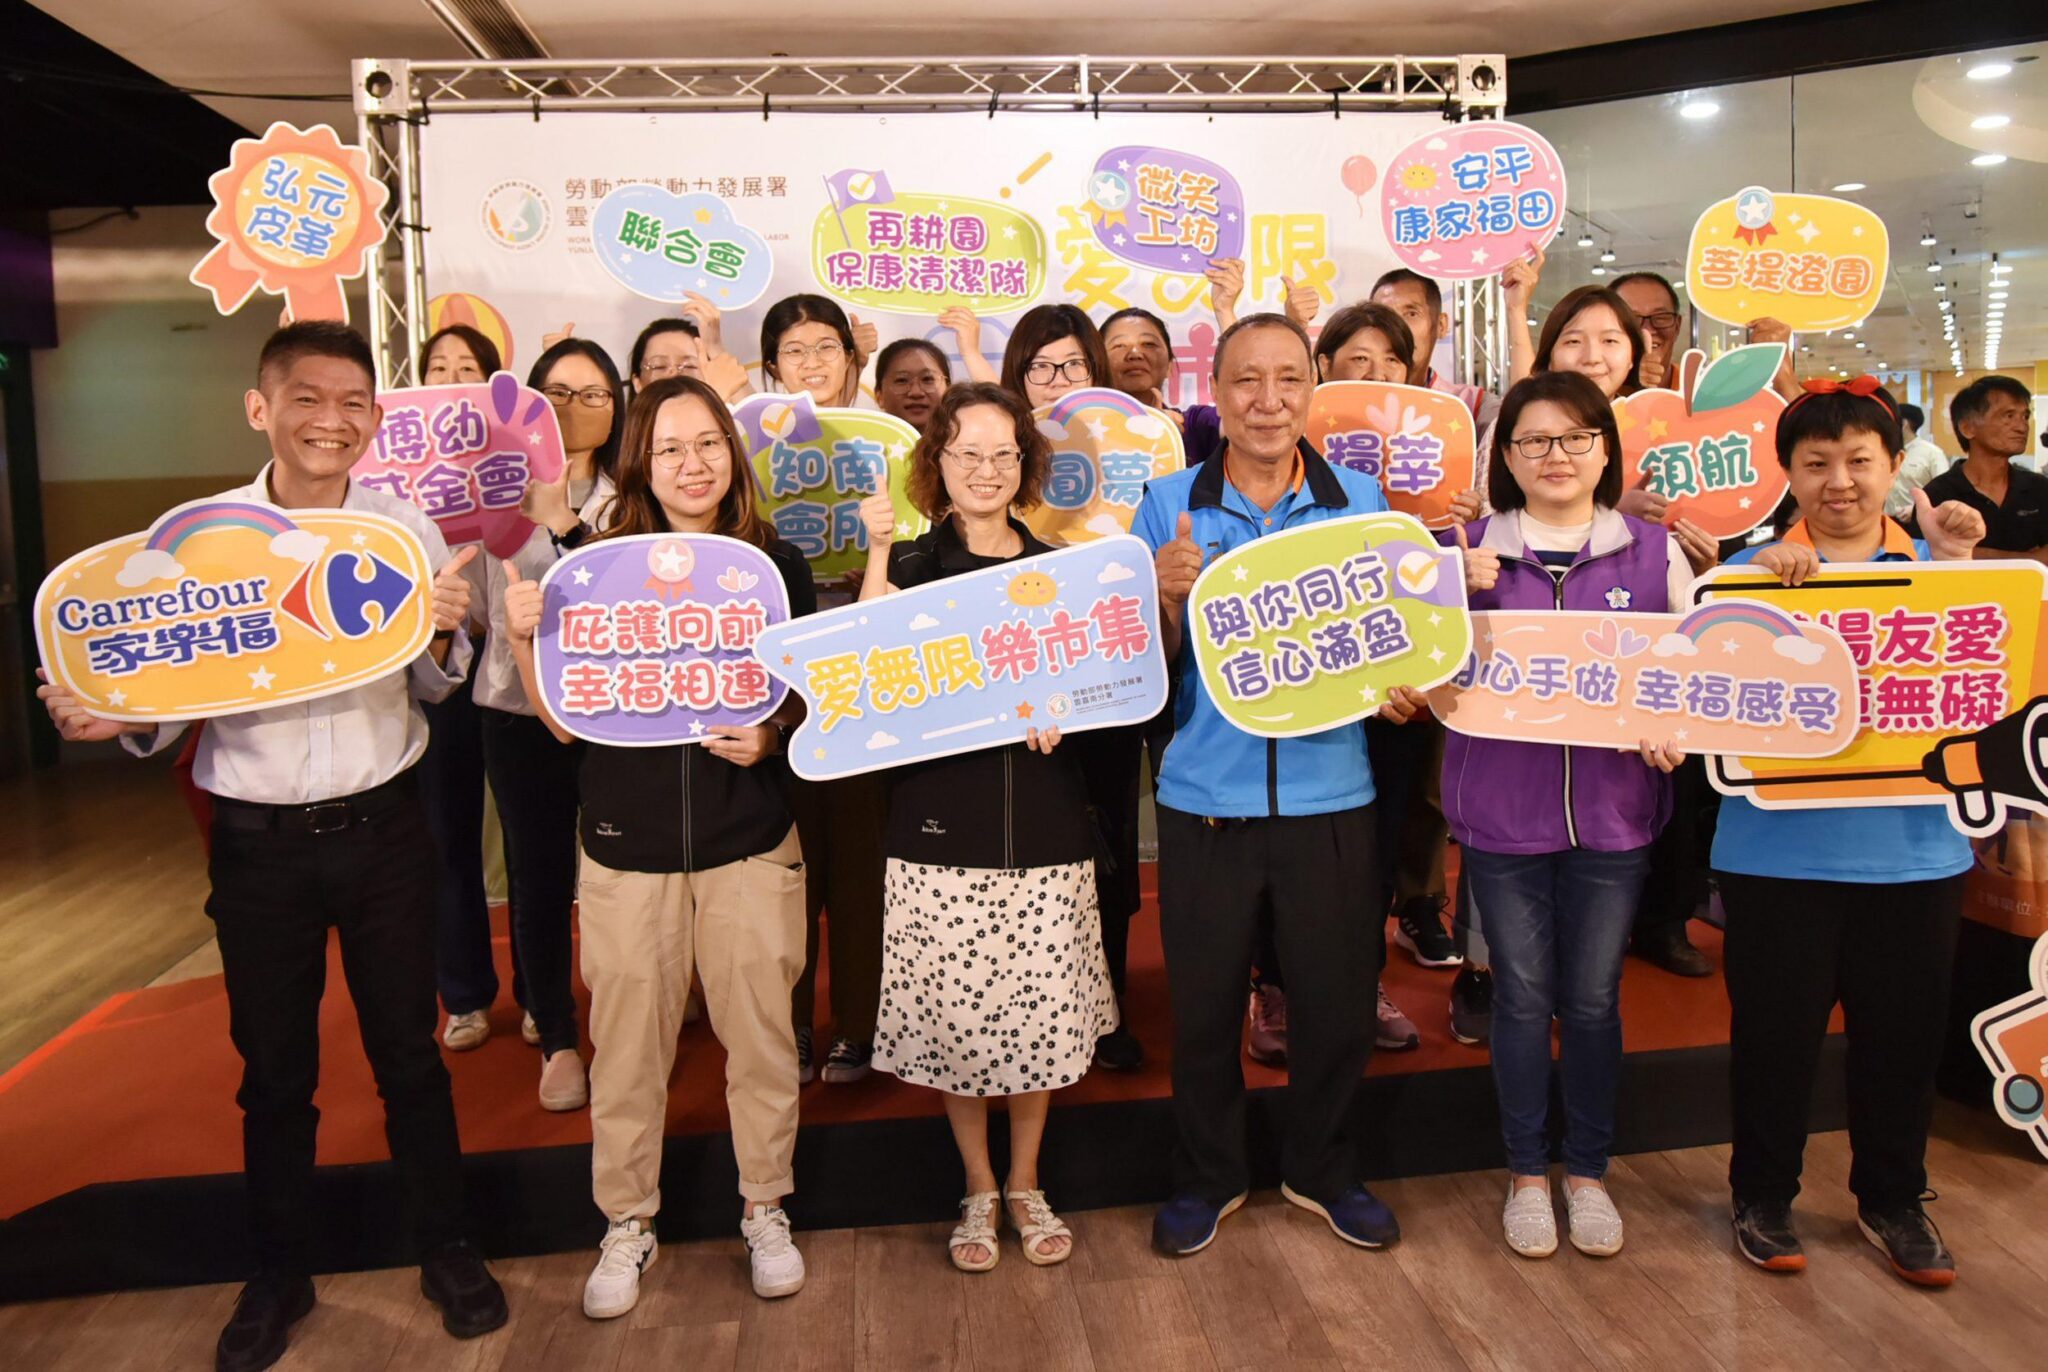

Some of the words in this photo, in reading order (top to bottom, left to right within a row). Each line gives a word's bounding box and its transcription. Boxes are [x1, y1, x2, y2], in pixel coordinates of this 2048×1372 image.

[263, 158, 346, 217] 弘元
[565, 176, 788, 199] 勞動動力發展署
[1138, 165, 1217, 212] 微笑
[1451, 146, 1531, 190] 安平
[247, 206, 335, 256] 皮革
[868, 211, 985, 251] 再耕園
[1136, 205, 1216, 252] 工坊
[1394, 190, 1554, 243] 康家福田
[618, 210, 746, 279] 聯合會
[826, 252, 1025, 295] 保康清潔隊
[1700, 248, 1870, 296] 菩提澄園
[373, 400, 484, 460] 博幼
[772, 439, 884, 495] 知南
[1041, 452, 1152, 507] 圓夢
[1640, 434, 1755, 498] 領航
[57, 577, 268, 632] Carrefour
[561, 602, 763, 650] 庇護向前
[1203, 555, 1386, 646] 與你同行
[87, 611, 278, 675] 家樂福
[1220, 608, 1409, 697] 信心滿盈
[563, 660, 770, 710] 幸福相連
[1635, 669, 1837, 731] 幸福感受
